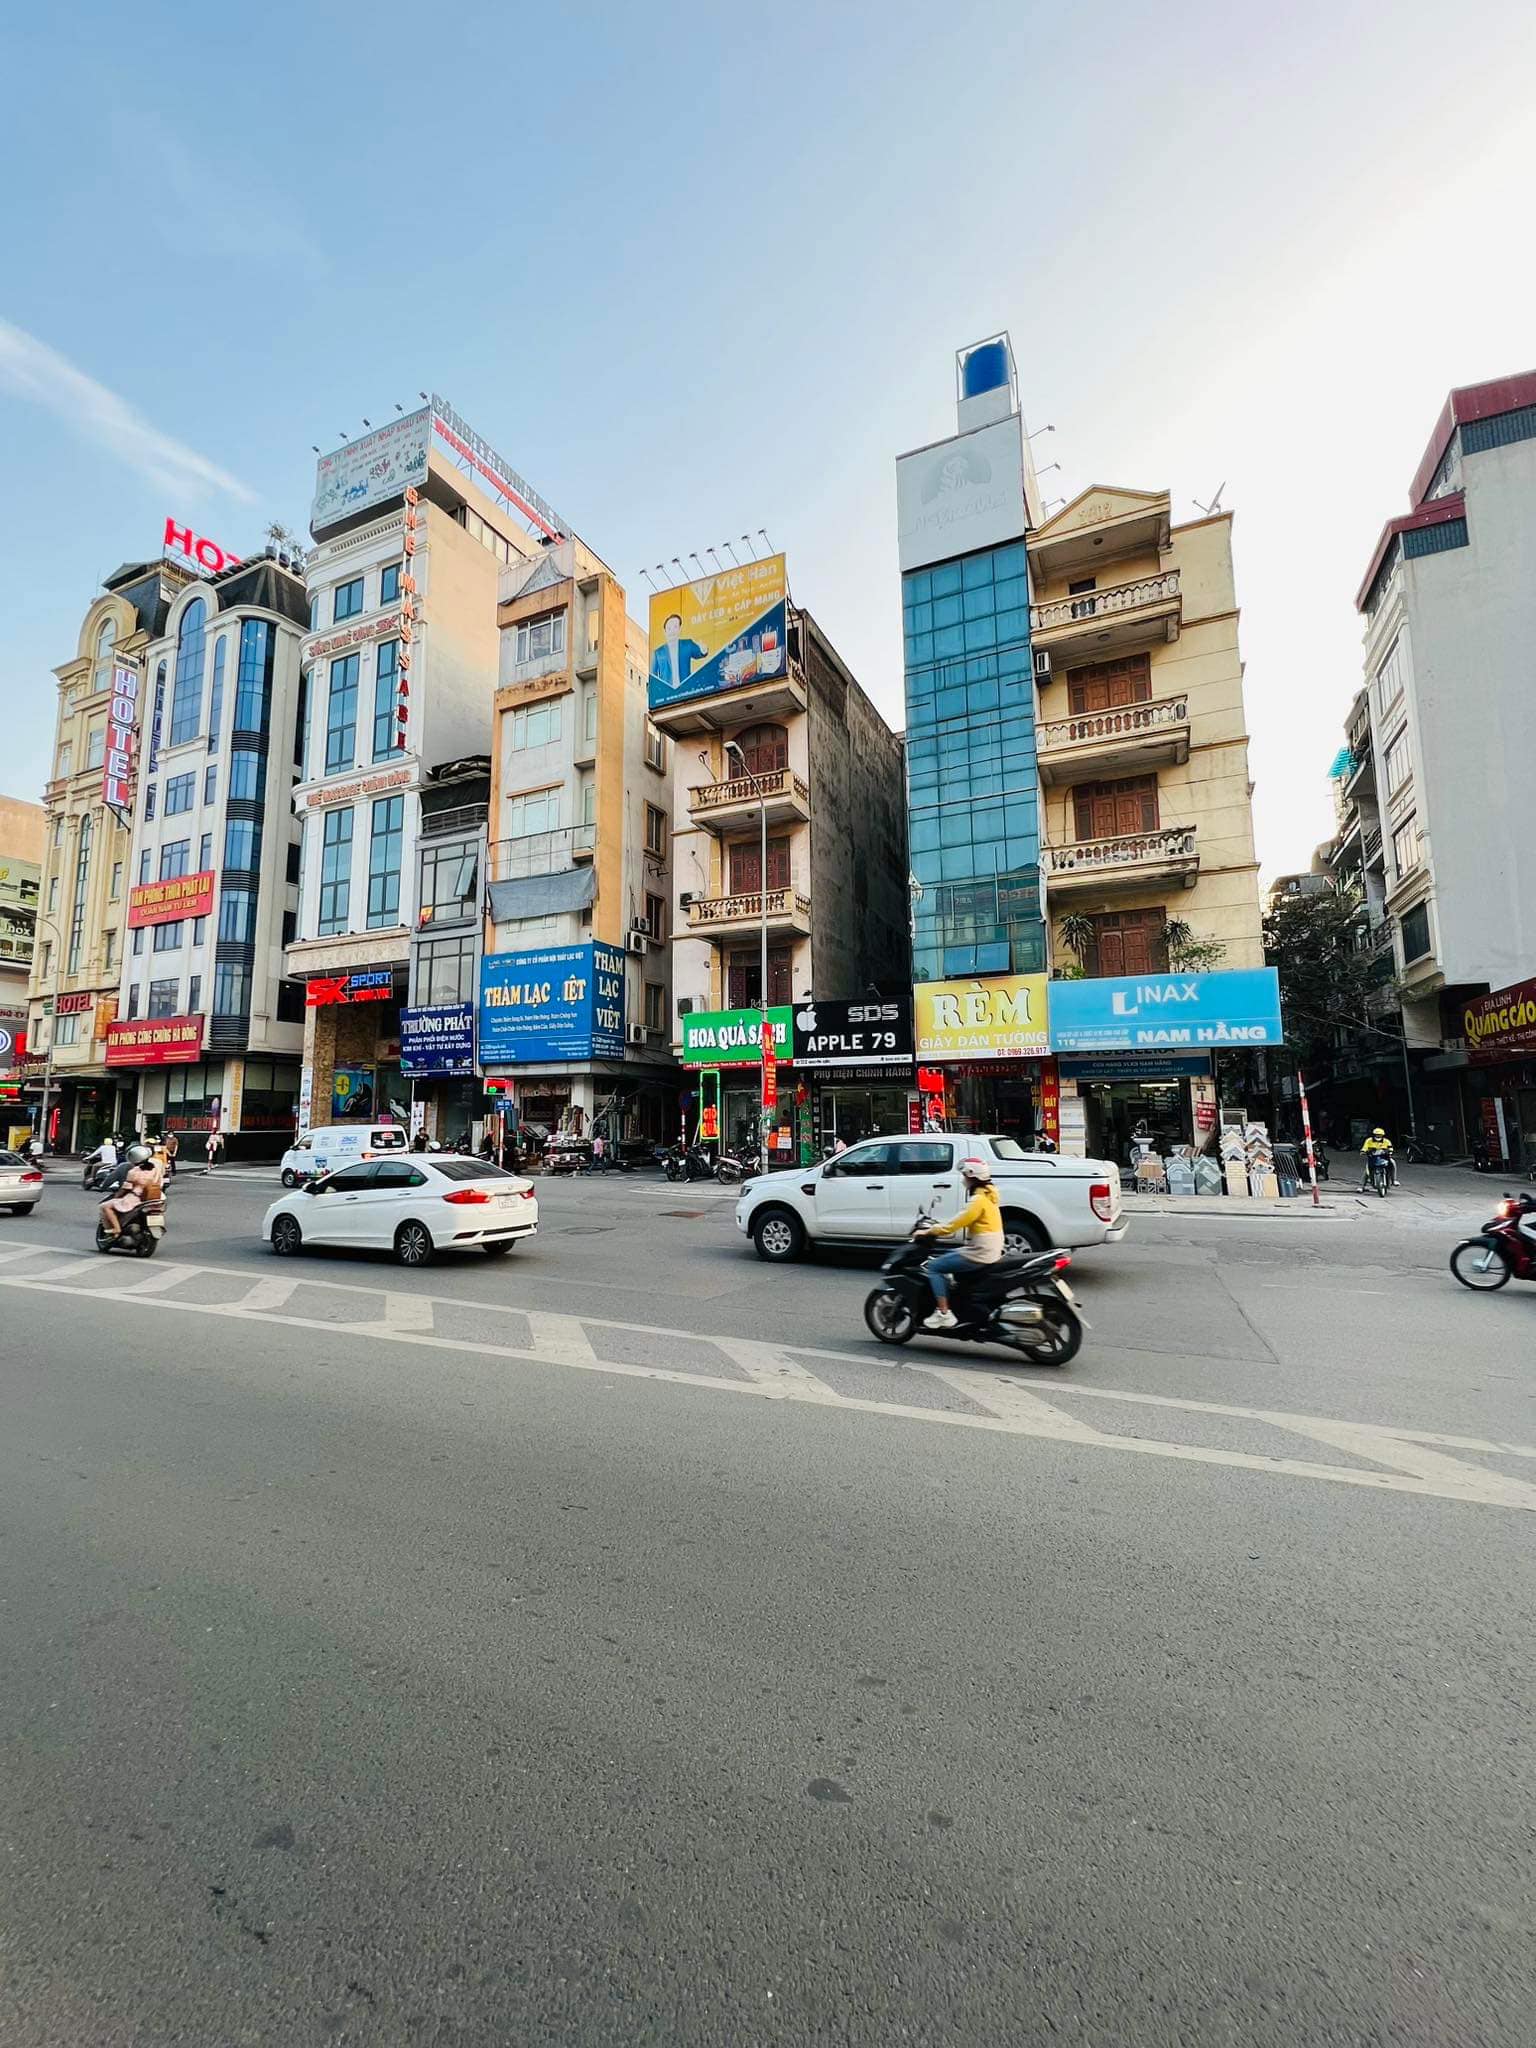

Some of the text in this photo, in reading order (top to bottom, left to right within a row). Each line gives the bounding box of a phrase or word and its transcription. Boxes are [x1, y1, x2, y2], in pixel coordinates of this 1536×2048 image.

[106, 667, 137, 807] HOTEL
[594, 947, 624, 976] THẢM
[350, 971, 391, 988] SPORT
[598, 976, 620, 1001] LẠC
[484, 978, 522, 1008] THẢM
[524, 981, 551, 1008] LẠC
[56, 994, 92, 1013] HOTEL
[847, 1003, 899, 1023] SDS
[931, 981, 1032, 1031] RÈM
[443, 1011, 473, 1031] PHÁT
[596, 1004, 621, 1033] VIỆT
[688, 1027, 717, 1048] HOA
[718, 1017, 747, 1050] QUẢ
[807, 1032, 896, 1052] APPLE 79
[958, 1032, 989, 1047] DÁN
[1137, 1028, 1190, 1043] NAM
[813, 1070, 831, 1080] PHỤ
